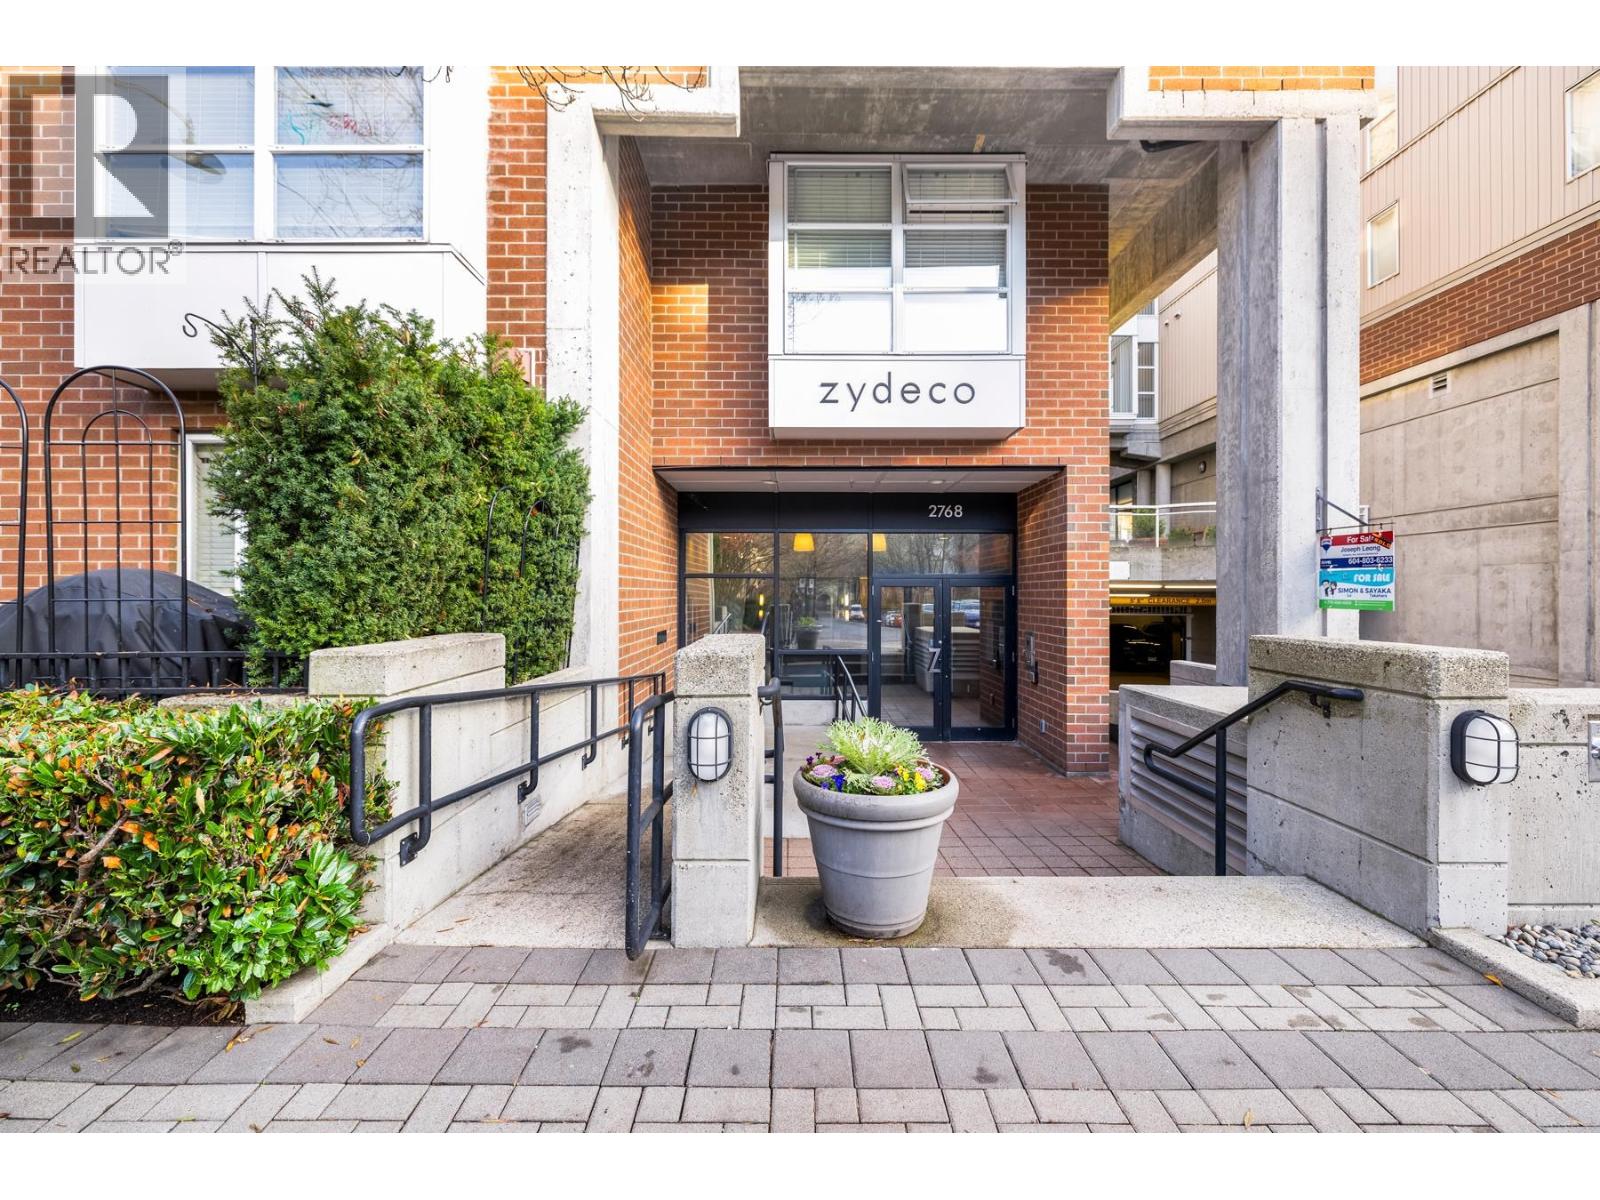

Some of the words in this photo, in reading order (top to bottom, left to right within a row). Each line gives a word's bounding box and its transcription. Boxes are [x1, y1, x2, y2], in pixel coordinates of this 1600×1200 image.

[819, 371, 976, 412] zydeco
[928, 504, 963, 518] 2768
[1353, 573, 1371, 583] FOR
[1373, 573, 1391, 582] SALE
